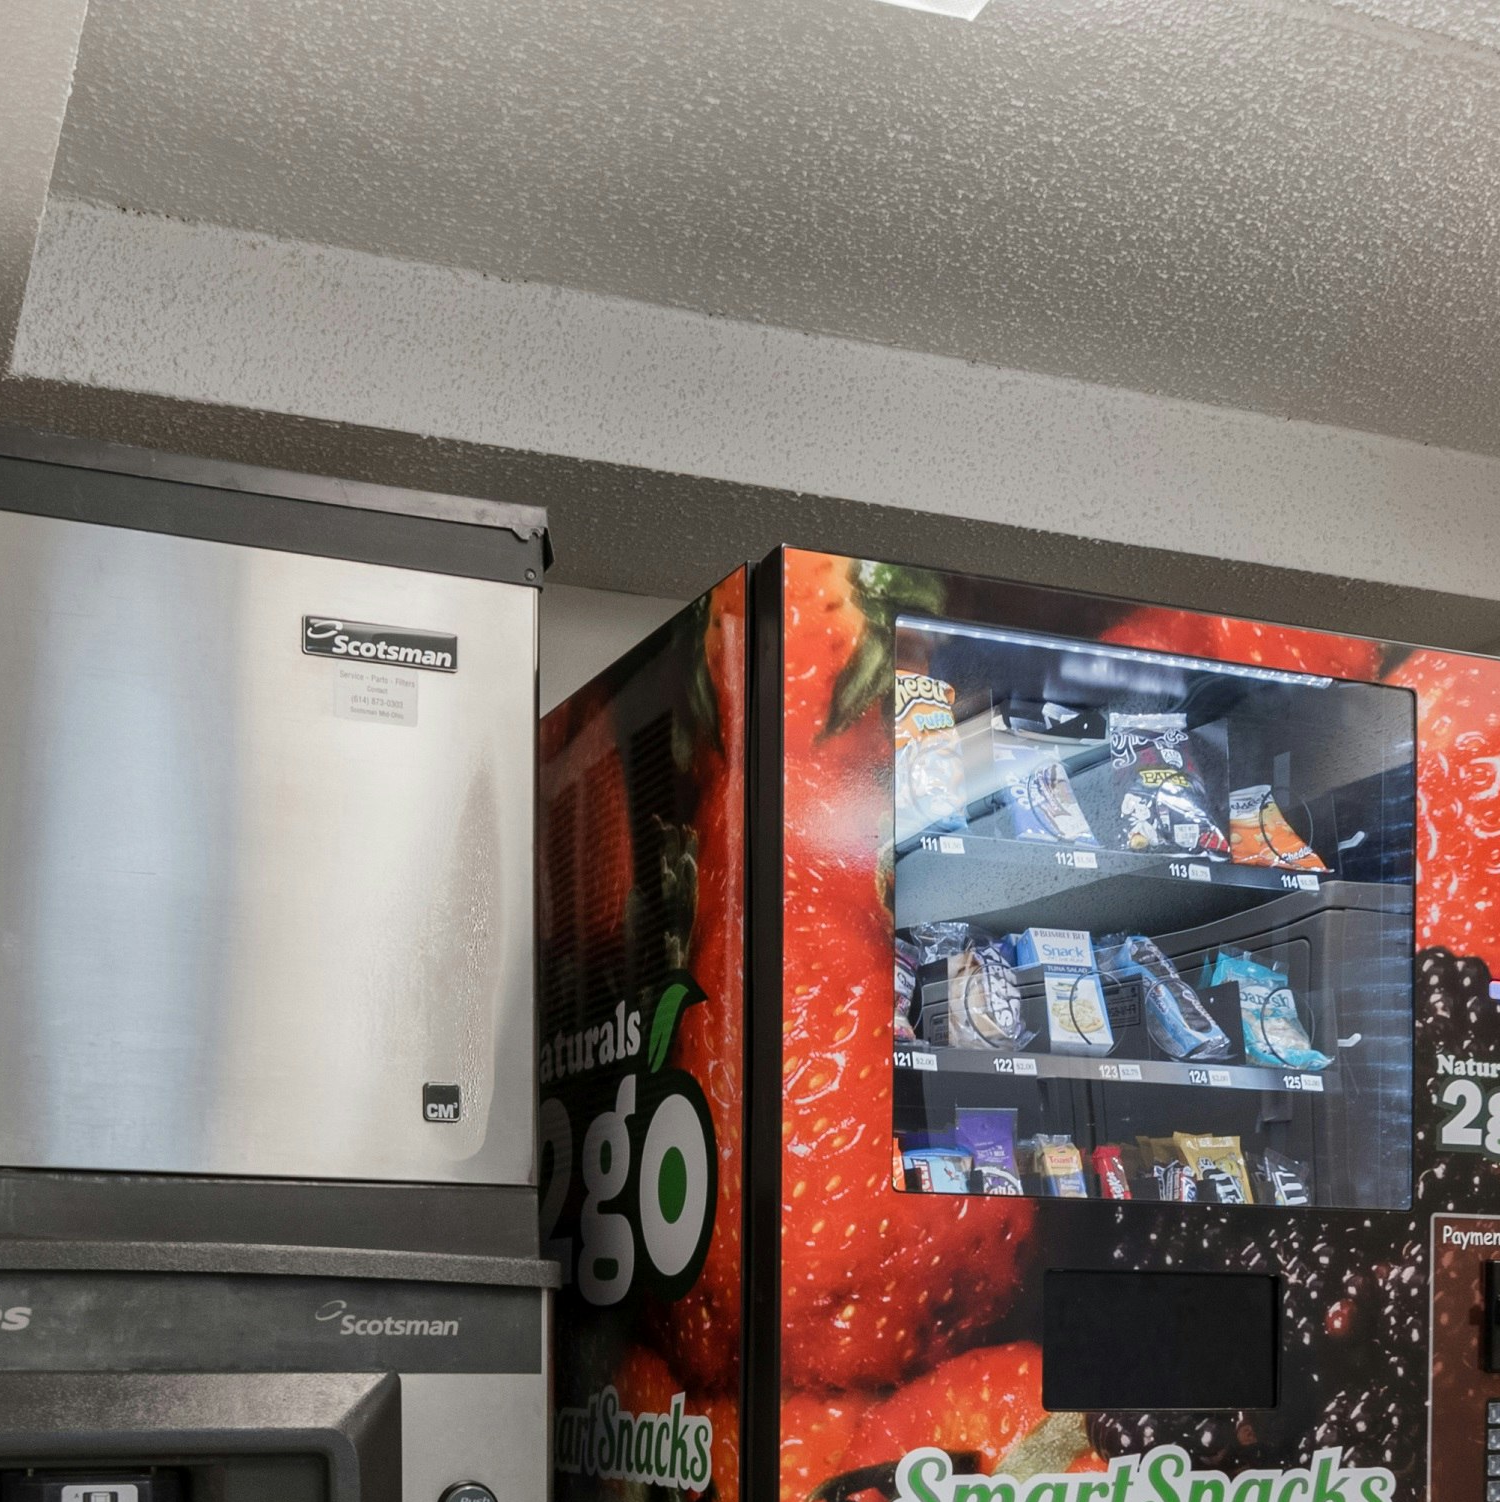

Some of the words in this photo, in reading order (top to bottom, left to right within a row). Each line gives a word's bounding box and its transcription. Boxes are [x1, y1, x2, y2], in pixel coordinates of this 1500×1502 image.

[332, 634, 453, 669] Scotsman
[920, 836, 938, 851] 111
[1055, 851, 1074, 866] 112
[1169, 863, 1187, 878] 113
[1281, 874, 1298, 889] 114
[1042, 943, 1085, 959] Snack
[540, 1000, 641, 1084] aturals
[894, 1051, 912, 1067] 121
[993, 1058, 1013, 1072] 122
[1099, 1064, 1118, 1078] 123
[1189, 1070, 1207, 1083] 124
[1283, 1075, 1301, 1089] 125
[339, 1313, 460, 1338] Scotsman
[555, 1392, 709, 1483] artSnacks
